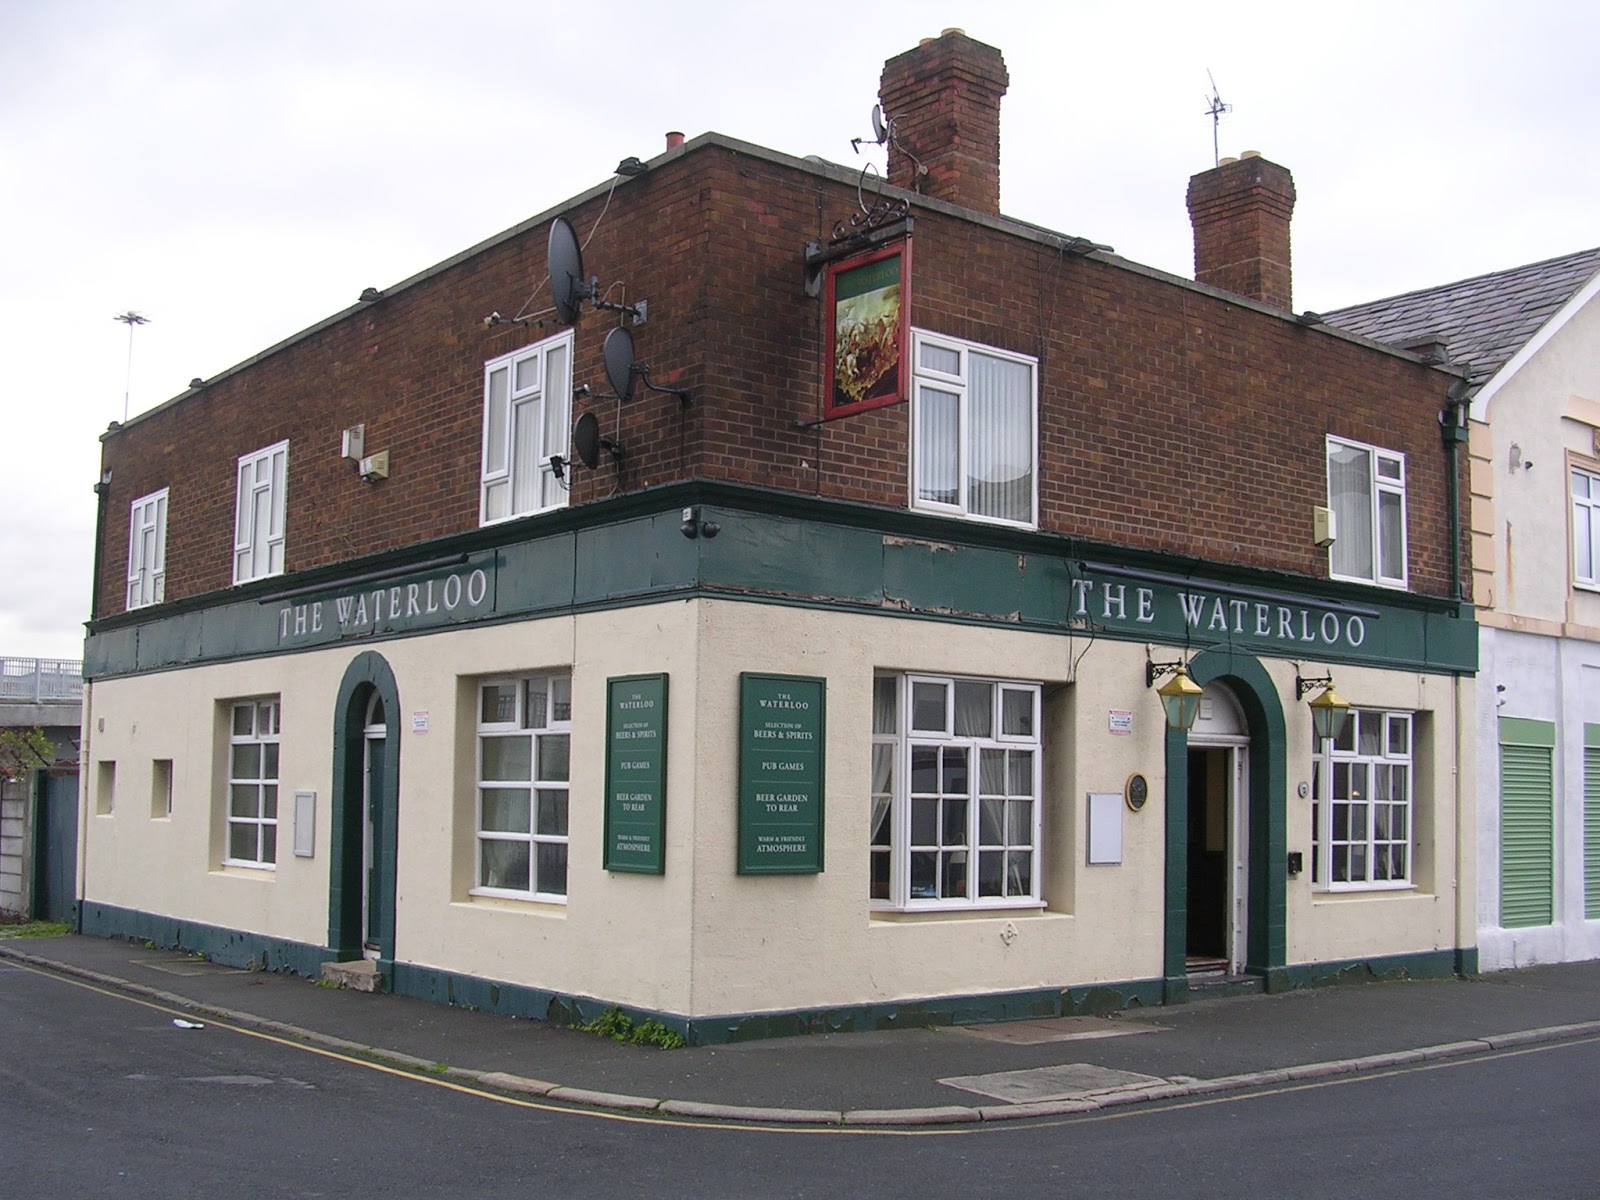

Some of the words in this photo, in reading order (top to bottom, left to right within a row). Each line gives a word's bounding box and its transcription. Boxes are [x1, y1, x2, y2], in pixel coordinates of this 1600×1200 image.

[280, 602, 323, 638] THE
[336, 569, 487, 627] WATERLOO
[1073, 579, 1155, 623] THE
[1178, 592, 1365, 647] WATERLOO
[619, 699, 654, 709] WATERLOO
[759, 699, 809, 710] WATERLOO
[615, 731, 631, 739] BEERS
[637, 729, 657, 739] SPIRITS
[753, 730, 777, 738] BEERS
[777, 731, 785, 739] &
[786, 731, 813, 740] SPIRITS
[632, 761, 650, 769] GAMES
[762, 762, 777, 770] PUB
[778, 762, 804, 771] GAMES
[616, 793, 628, 801] BEER
[629, 793, 652, 801] GARDEN
[756, 793, 776, 802] BEER
[776, 794, 808, 802] GARDEN
[623, 803, 631, 811] TO
[631, 803, 645, 811] REAR
[766, 804, 777, 812] TO
[778, 804, 798, 812] REAR
[616, 842, 651, 852] ATMOSPHERE
[756, 844, 807, 853] ATMOSPHERE
